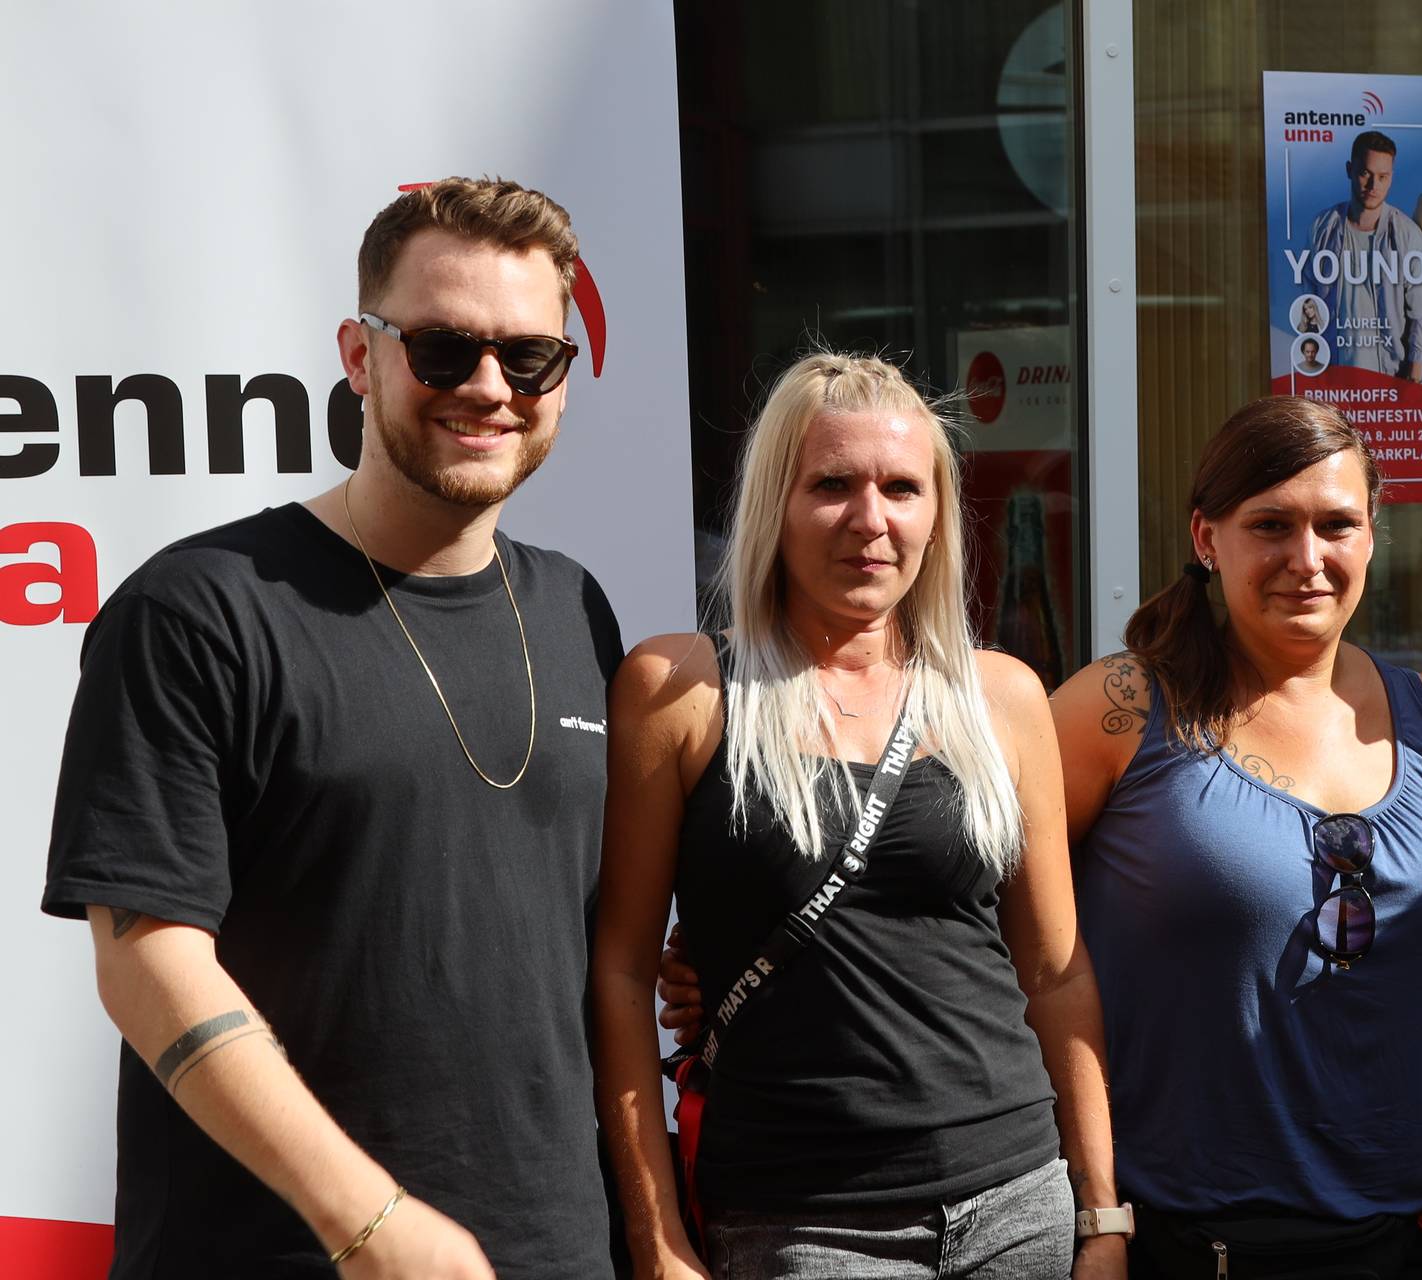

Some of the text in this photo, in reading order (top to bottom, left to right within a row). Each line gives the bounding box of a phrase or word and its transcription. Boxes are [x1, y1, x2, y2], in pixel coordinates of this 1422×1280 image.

[1284, 110, 1365, 127] antenne
[1284, 128, 1334, 143] unna
[1336, 317, 1392, 330] LAURELL
[1336, 335, 1393, 348] DJ JUF-X
[1304, 388, 1398, 402] BRINKHOFFS
[1375, 430, 1386, 441] 8.
[1388, 430, 1414, 441] JULI
[850, 791, 888, 855] RIGHT
[717, 968, 761, 1027] THAT'S
